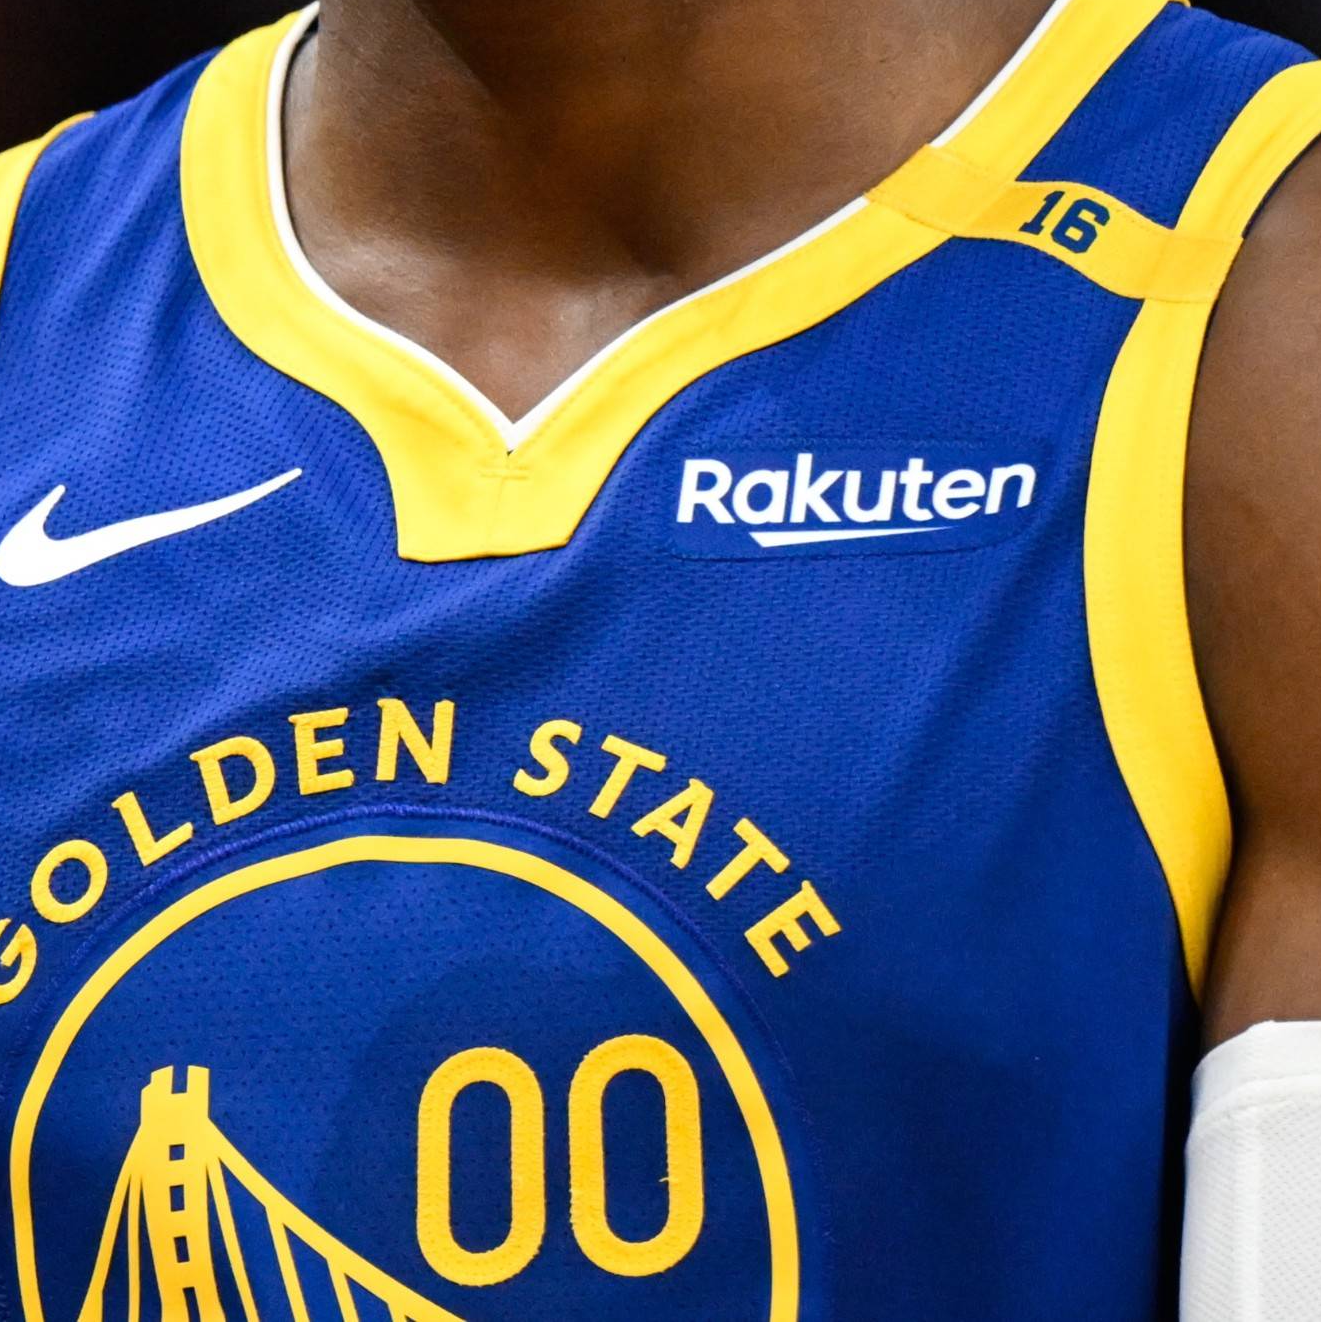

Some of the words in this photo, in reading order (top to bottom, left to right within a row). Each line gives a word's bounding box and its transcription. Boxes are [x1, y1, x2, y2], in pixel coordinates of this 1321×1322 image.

[1018, 189, 1110, 255] 16
[676, 453, 1036, 525] Rakuten
[513, 719, 841, 979] STATE
[416, 1033, 704, 1287] 00
